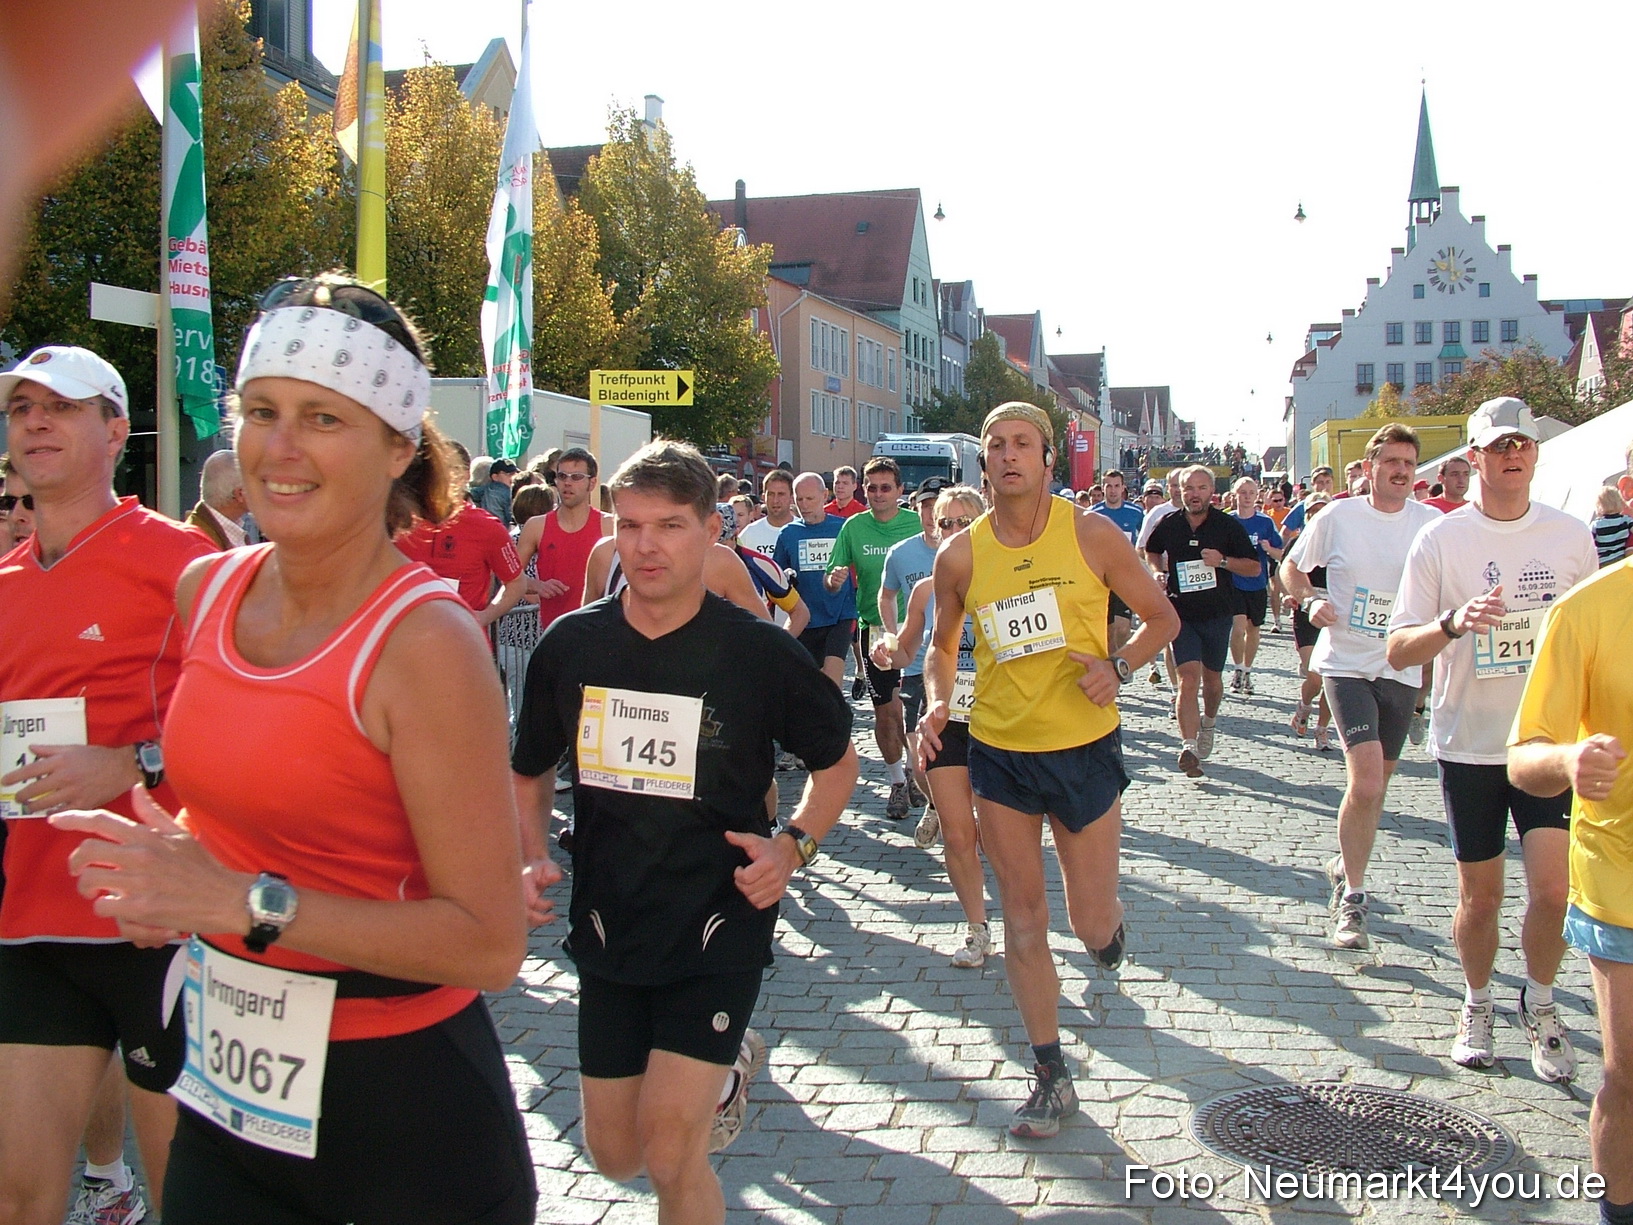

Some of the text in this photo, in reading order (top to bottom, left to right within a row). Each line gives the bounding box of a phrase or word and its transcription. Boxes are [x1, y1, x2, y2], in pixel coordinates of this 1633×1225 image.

[168, 259, 208, 277] Miets
[598, 374, 666, 387] Treffpunkt
[598, 389, 670, 403] Bladenight
[756, 544, 775, 554] SYS
[810, 552, 832, 562] 341
[905, 571, 925, 584] POLO
[1188, 572, 1213, 584] 2893
[1518, 582, 1557, 592] 16.09.2007
[995, 591, 1036, 612] Wilfried
[1369, 594, 1392, 606] Peter
[1008, 613, 1048, 638] 810
[1367, 611, 1391, 627] 32
[1498, 638, 1534, 658] 211
[611, 698, 670, 723] Thomas
[583, 725, 590, 739] B
[1346, 724, 1369, 737] ODLO
[621, 736, 677, 768] 145
[646, 778, 692, 792] PFLEIDERER
[207, 966, 287, 1022] Irmgard
[209, 1029, 306, 1100] 3067
